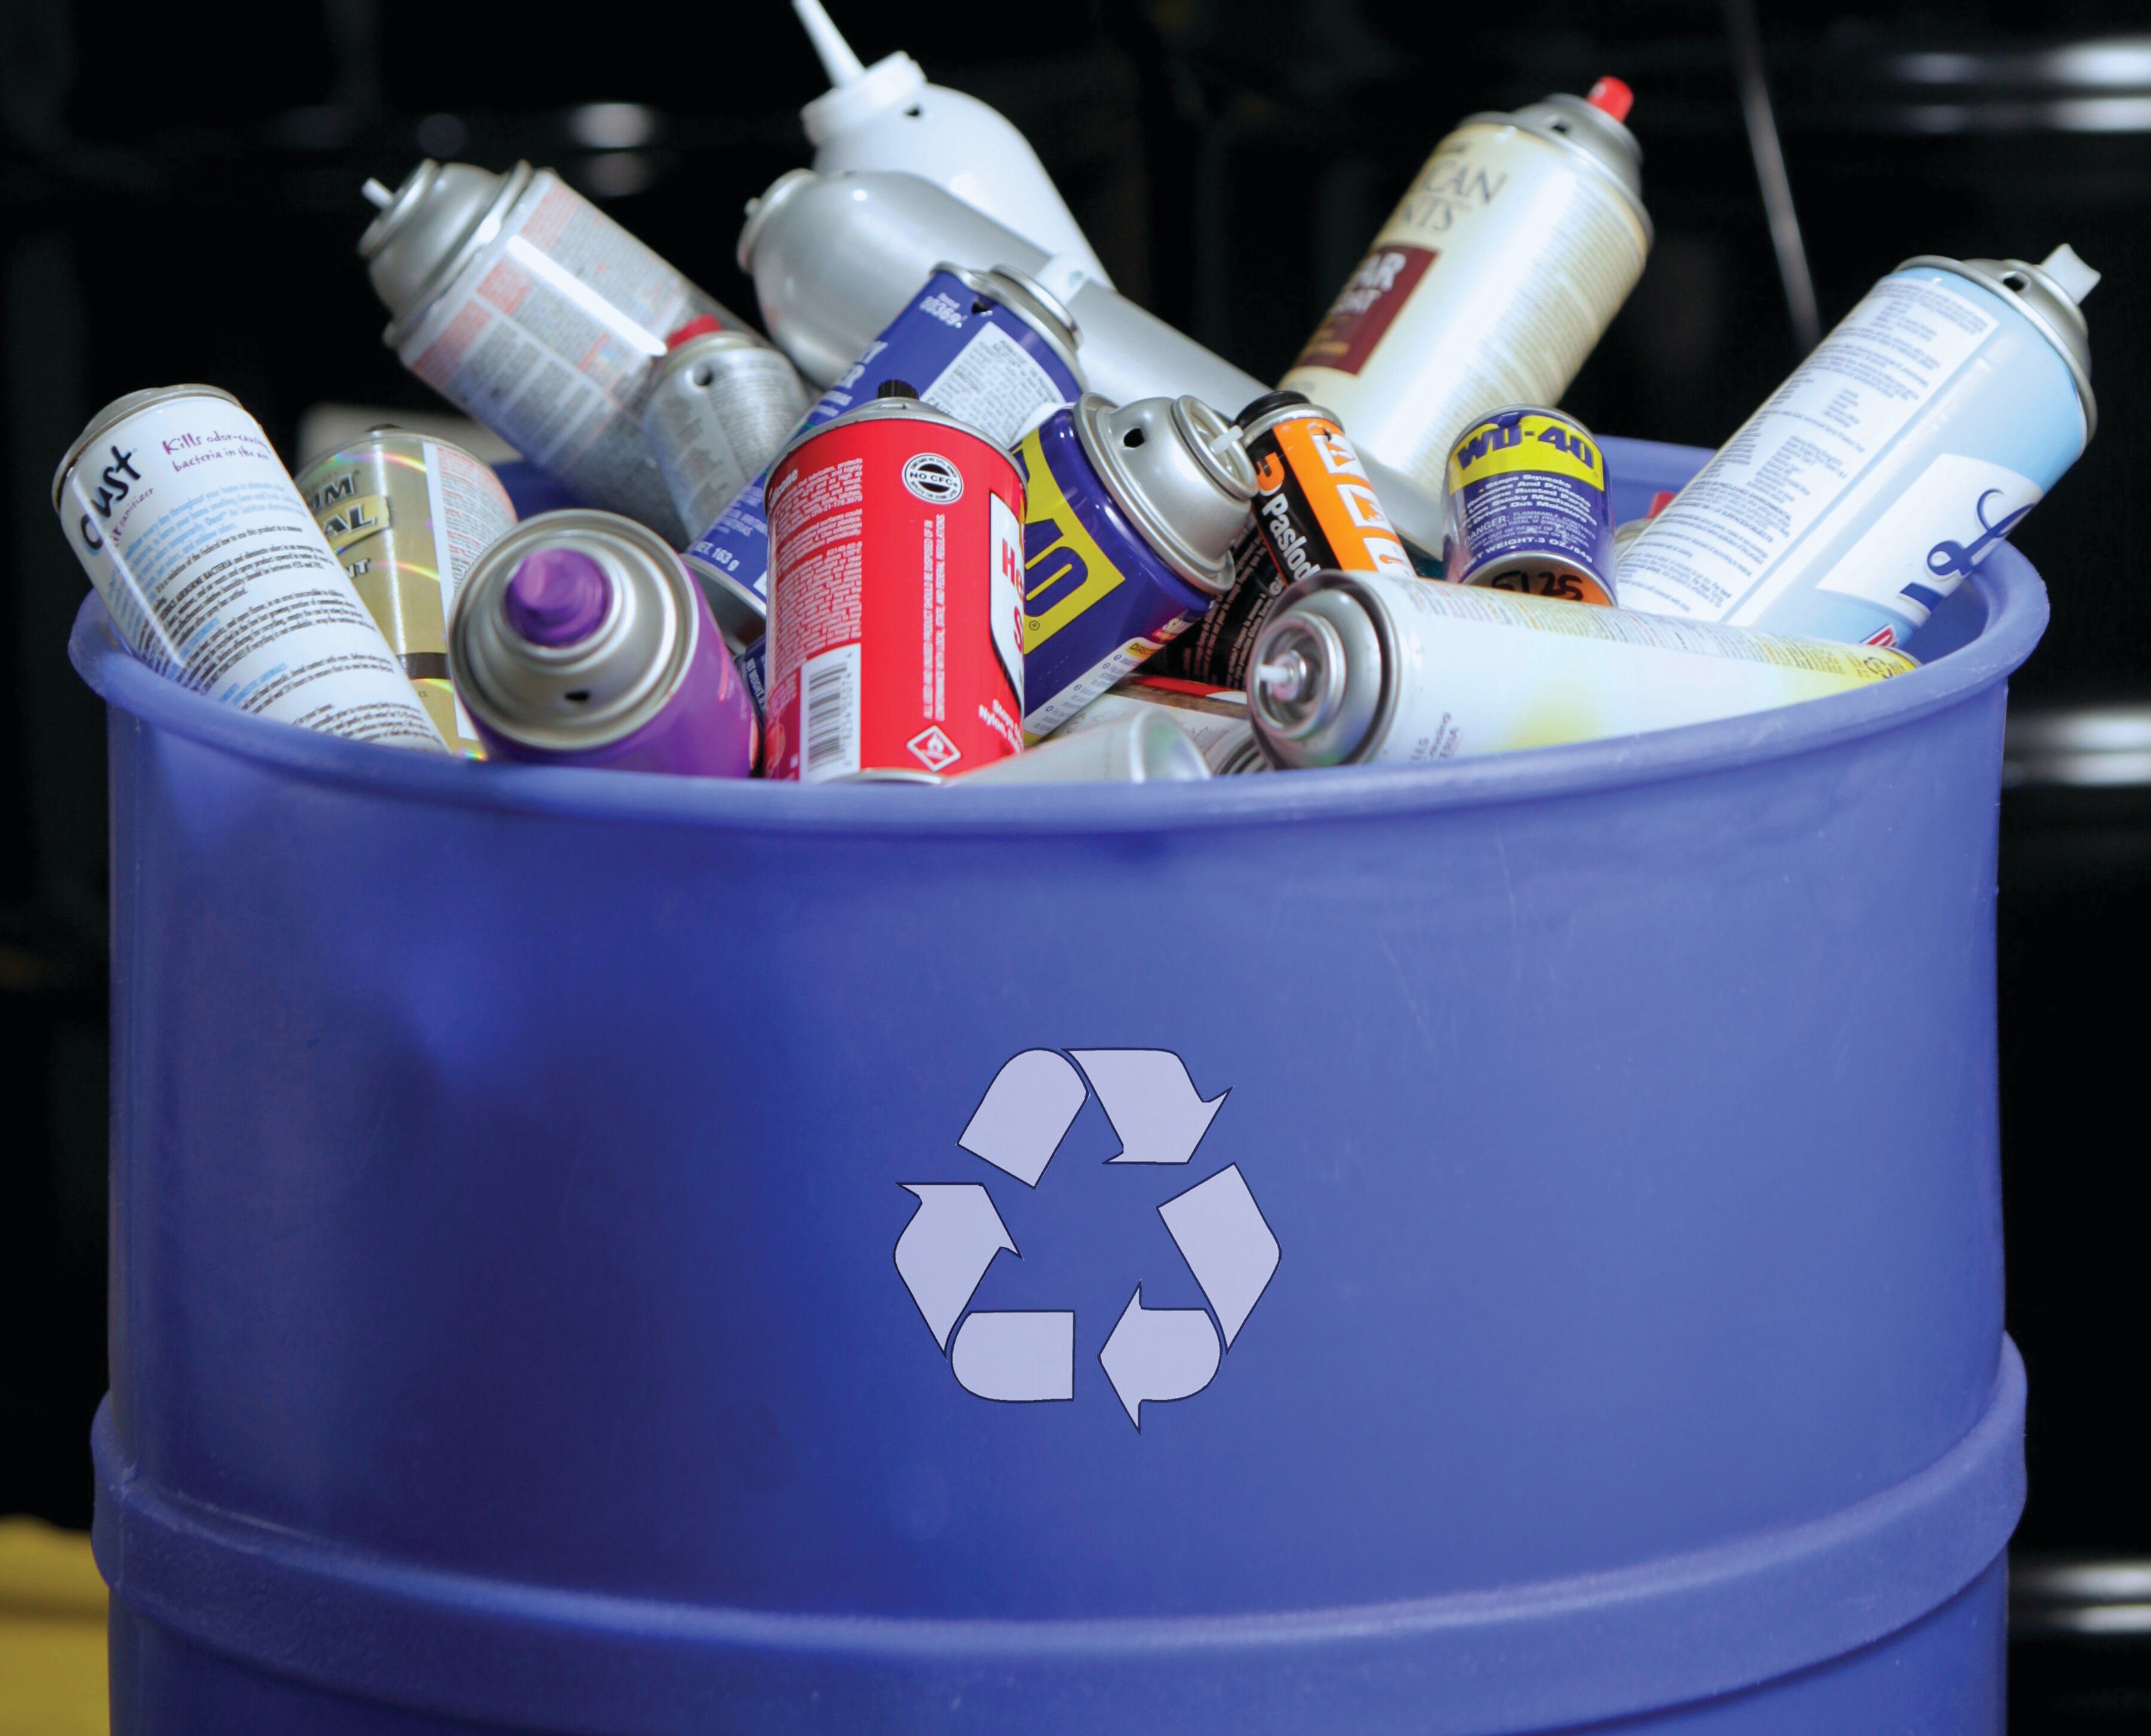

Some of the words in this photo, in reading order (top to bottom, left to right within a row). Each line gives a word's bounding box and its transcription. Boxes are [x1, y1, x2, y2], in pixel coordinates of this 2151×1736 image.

[161, 433, 202, 456] Kills
[1457, 425, 1595, 470] WD-40
[172, 449, 222, 472] bacteria
[225, 447, 236, 457] in
[909, 471, 927, 480] NO
[930, 474, 958, 487] CFCs
[1522, 474, 1572, 489] Squeaks
[120, 487, 154, 527] sanitizer
[1491, 494, 1528, 507] Sticky
[1515, 487, 1558, 496] Rusted
[1559, 493, 1590, 513] Parts
[1536, 500, 1587, 523] Moisture
[1262, 493, 1322, 581] Paslod
